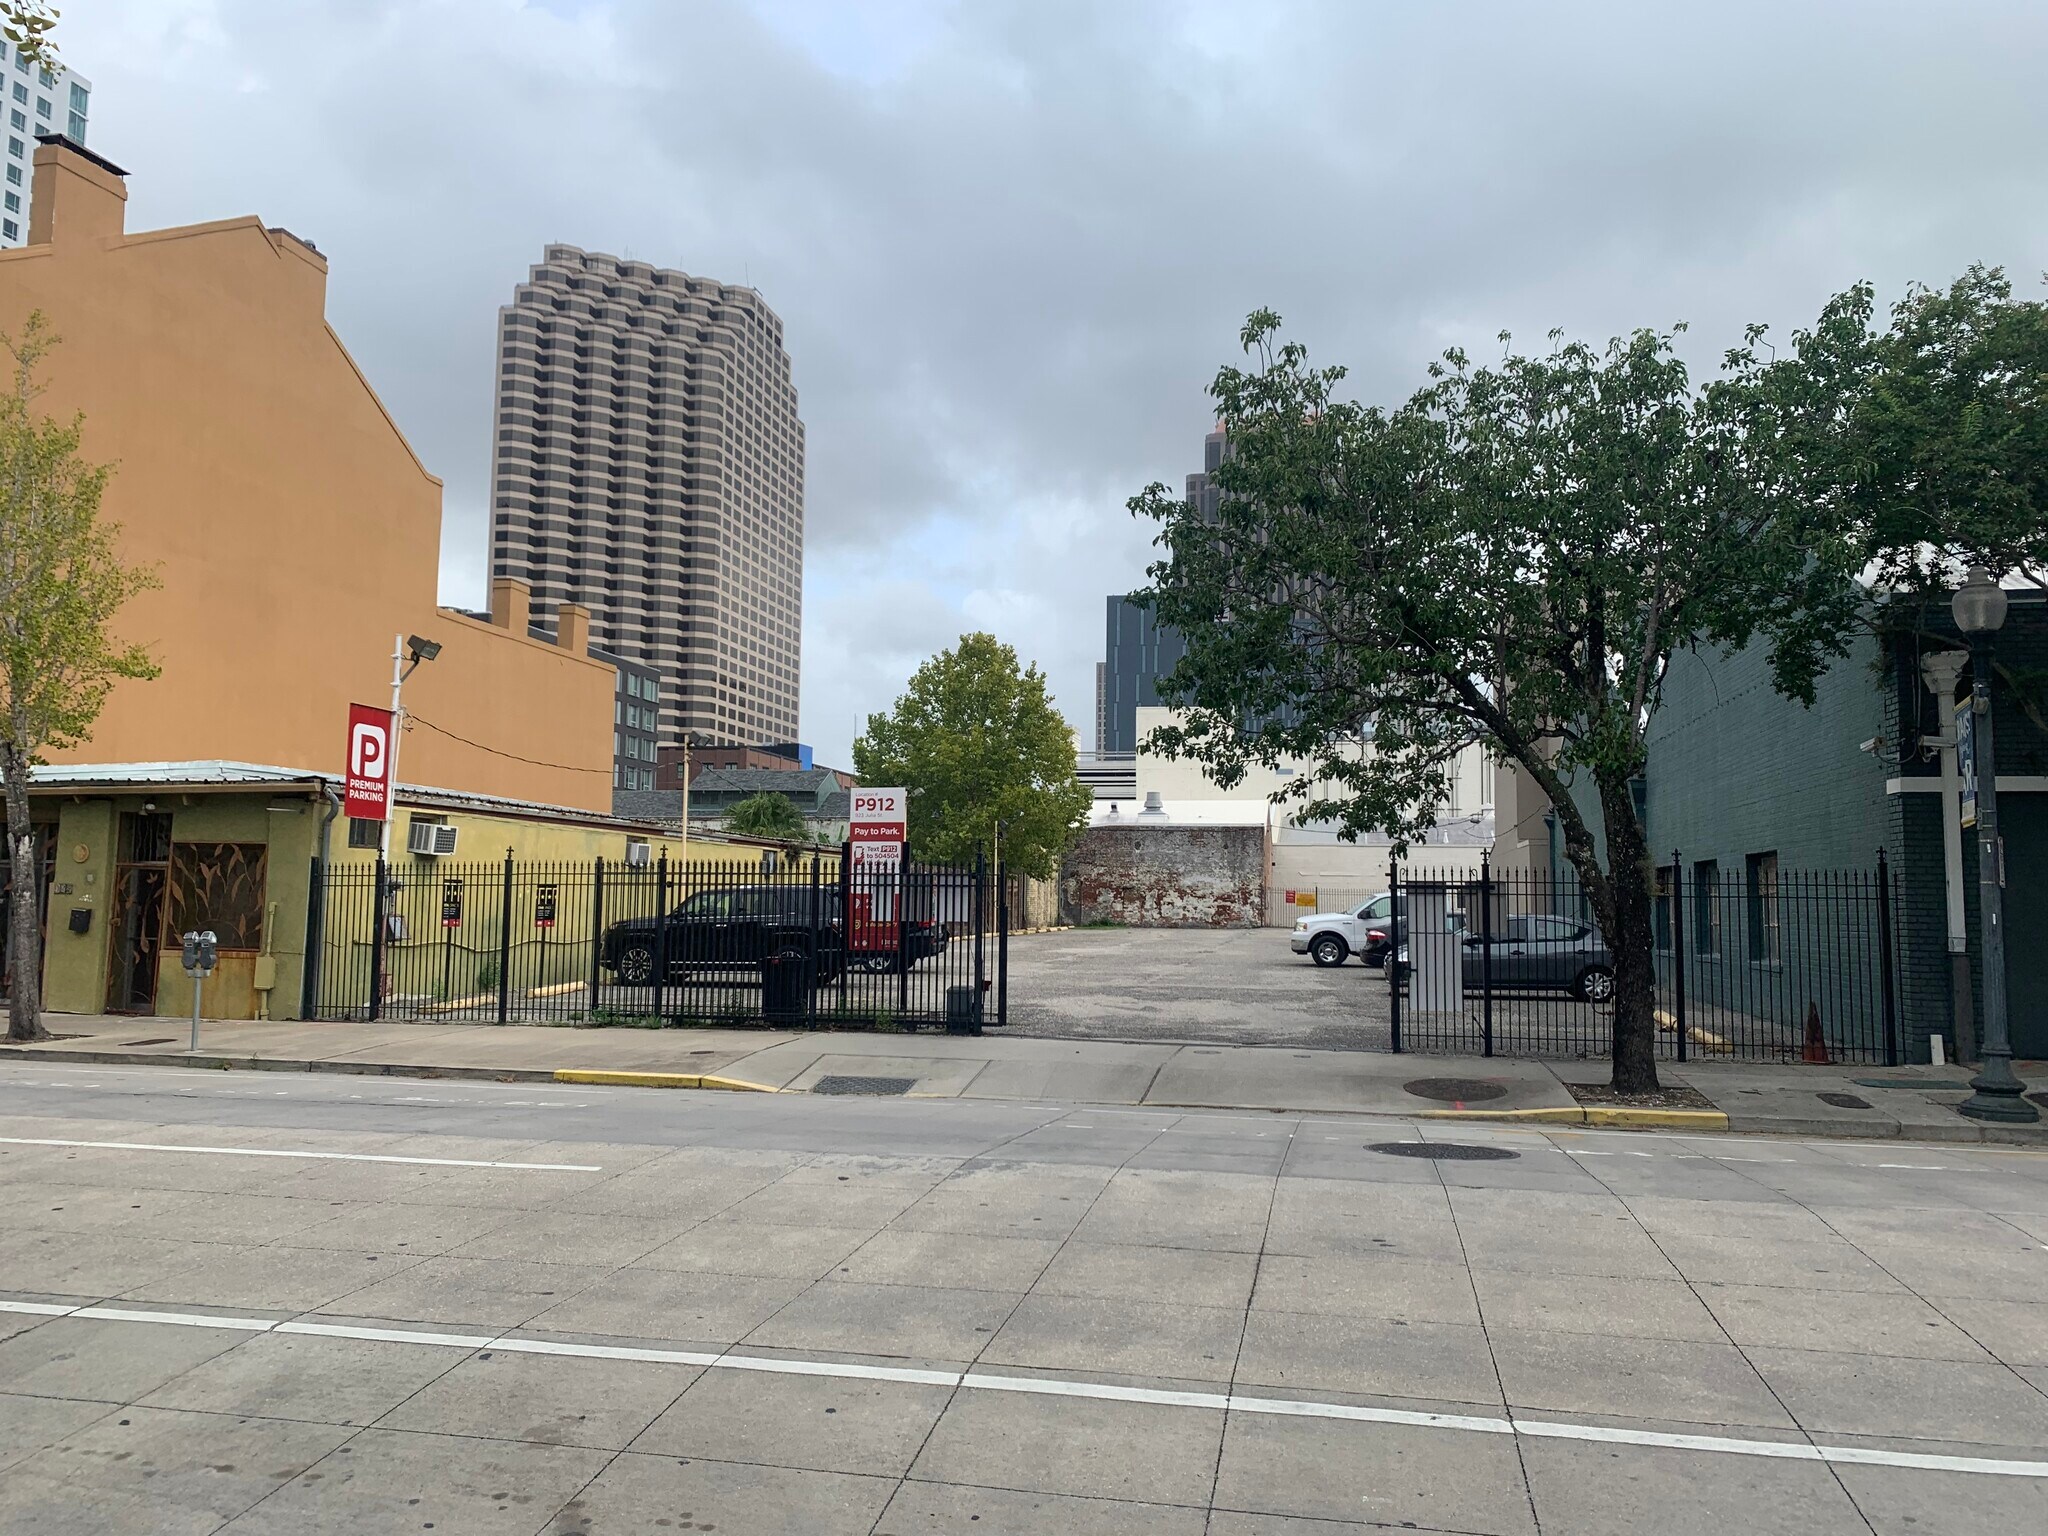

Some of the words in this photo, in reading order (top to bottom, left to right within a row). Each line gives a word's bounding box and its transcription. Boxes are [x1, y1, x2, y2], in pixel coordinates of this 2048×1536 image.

[350, 779, 384, 792] PREMIUM
[349, 789, 384, 802] PARKING
[855, 798, 894, 811] P912
[854, 828, 869, 836] Pay
[880, 827, 900, 835] Park.
